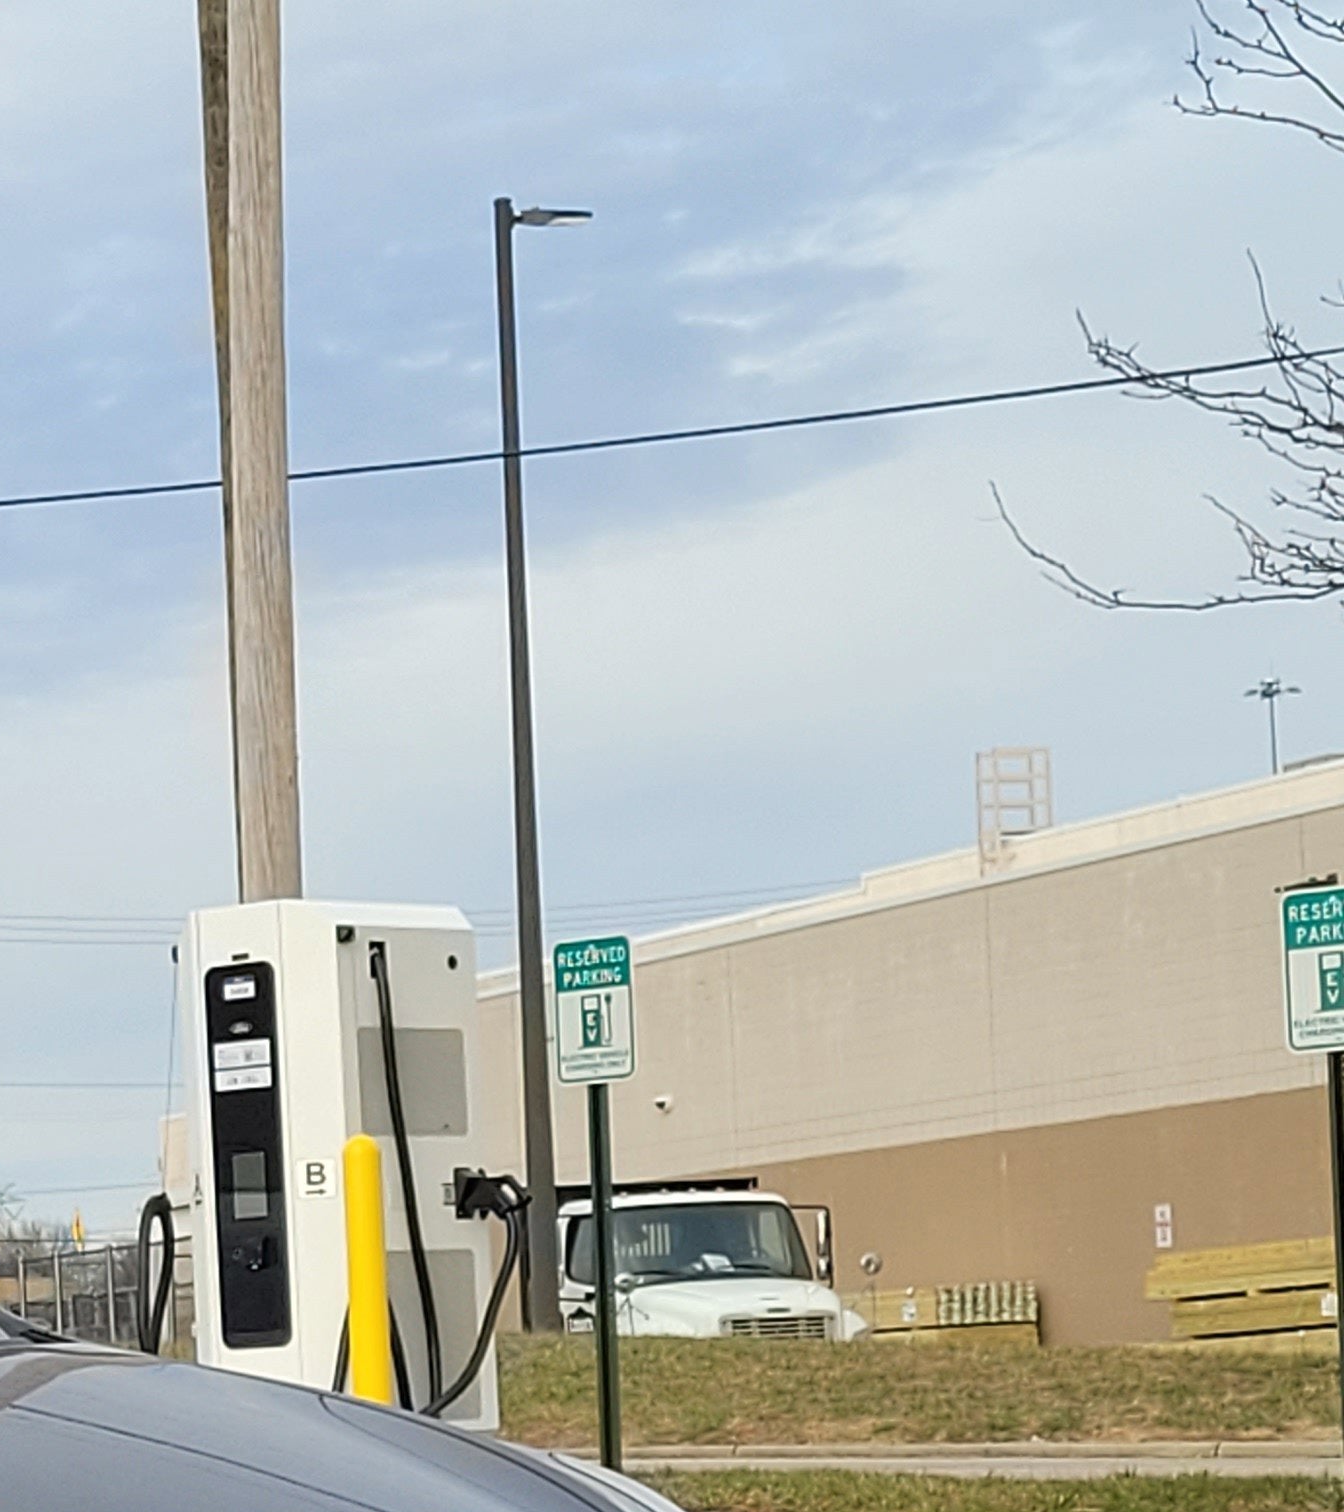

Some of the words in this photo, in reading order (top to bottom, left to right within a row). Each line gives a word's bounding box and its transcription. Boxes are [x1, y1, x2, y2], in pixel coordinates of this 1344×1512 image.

[1288, 899, 1344, 923] RESER
[1296, 923, 1344, 944] PARK
[557, 946, 626, 968] RESERVED
[563, 966, 623, 988] PARKING
[306, 1162, 326, 1186] B
